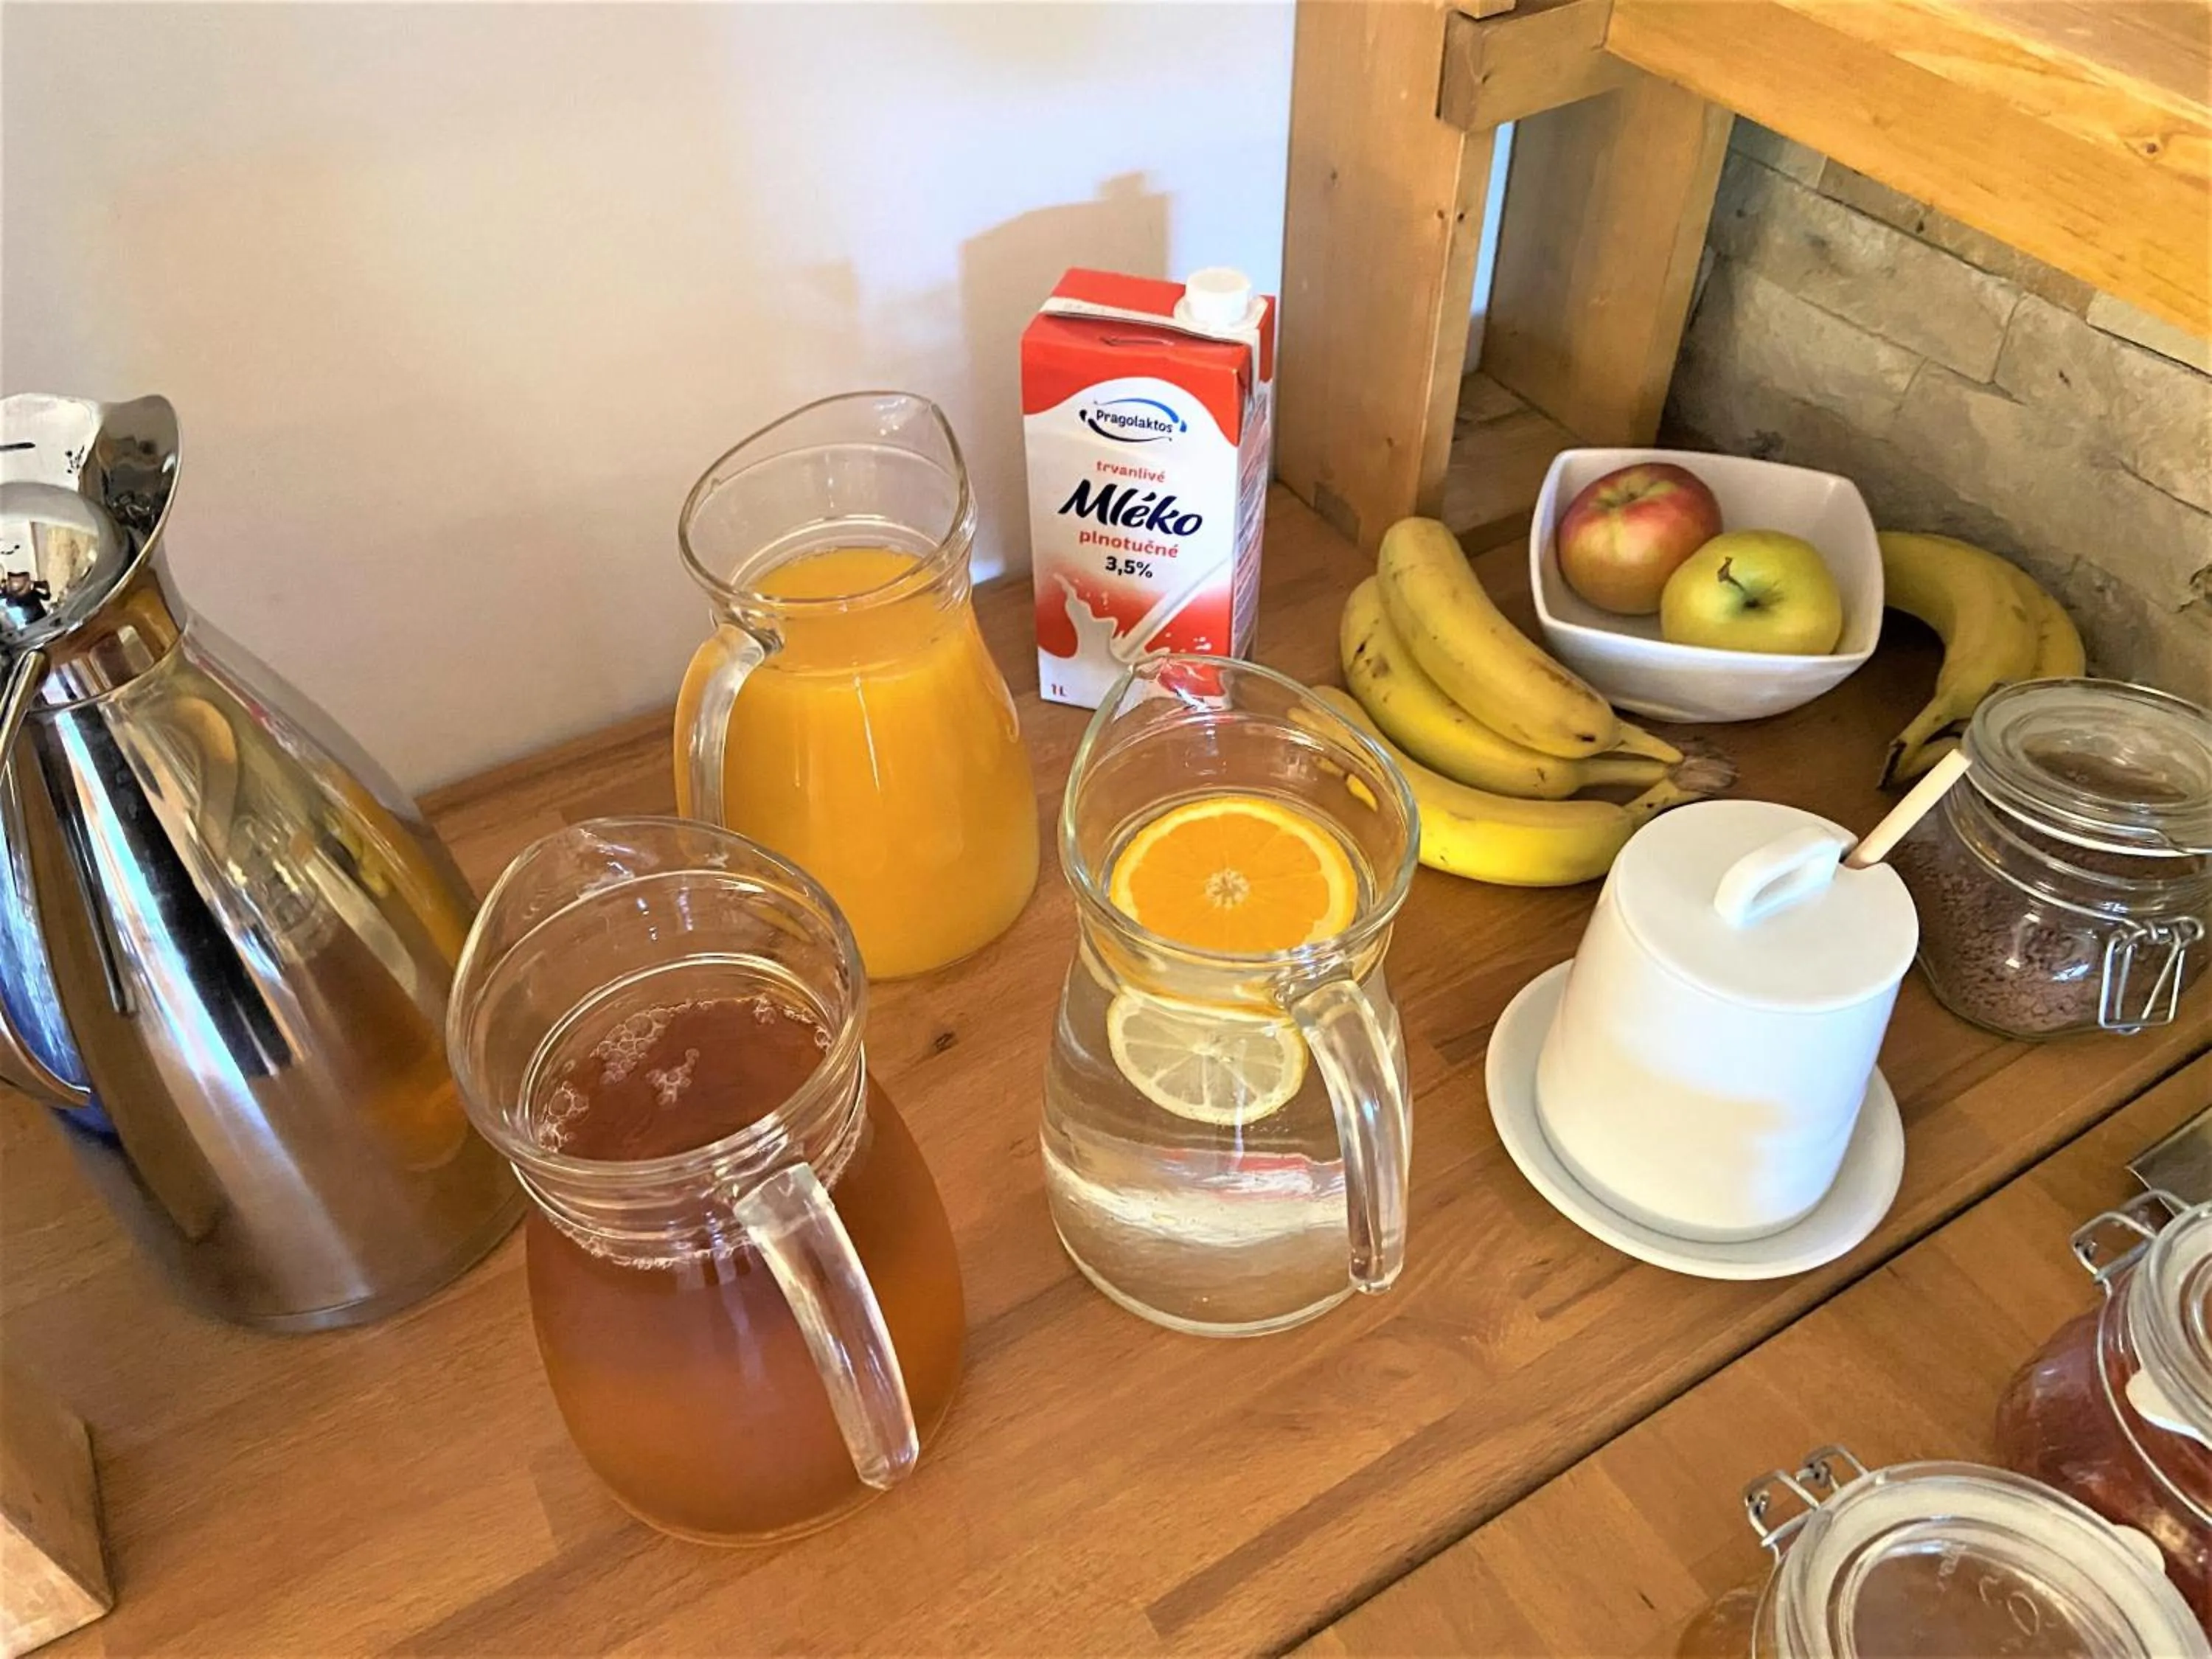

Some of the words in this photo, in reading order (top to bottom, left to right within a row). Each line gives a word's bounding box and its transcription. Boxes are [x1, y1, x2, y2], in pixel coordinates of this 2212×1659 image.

[1096, 409, 1173, 433] Pragolaktos
[1096, 460, 1166, 482] trvanlivé
[1057, 479, 1203, 536] Mléko
[1079, 530, 1179, 558] plnotučné
[1105, 556, 1153, 579] 3,5%
